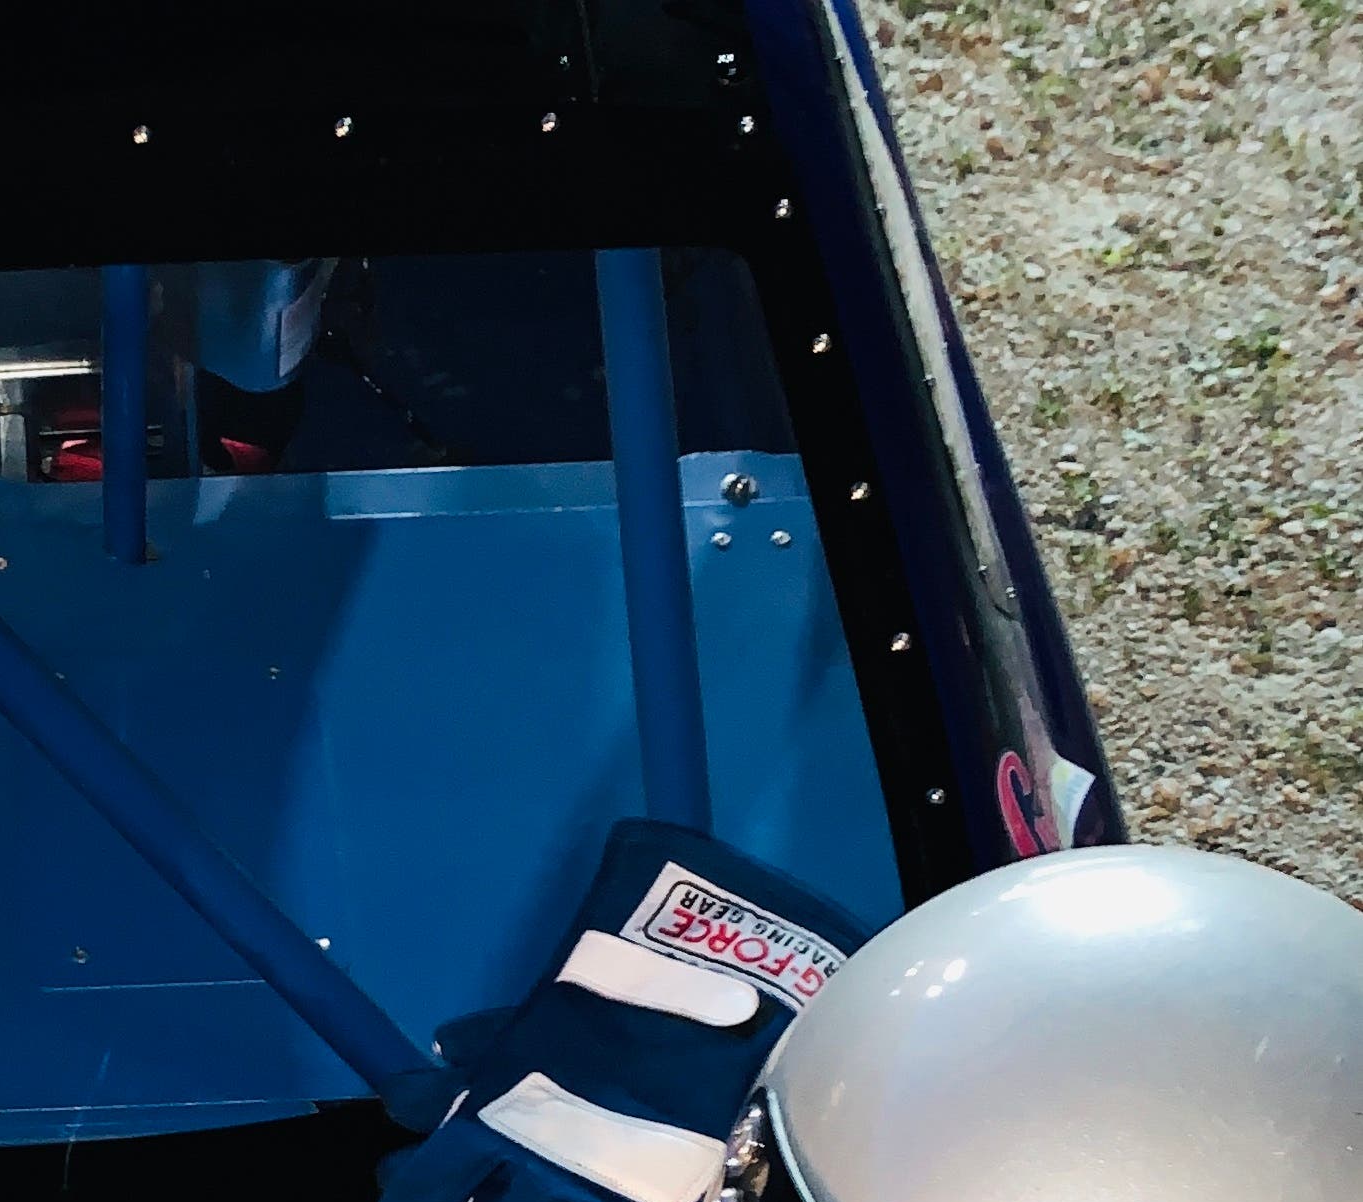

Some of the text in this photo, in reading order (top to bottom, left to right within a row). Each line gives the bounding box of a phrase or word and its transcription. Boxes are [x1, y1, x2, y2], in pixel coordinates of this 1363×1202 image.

[658, 907, 826, 998] G-FORCE
[679, 889, 841, 979] RACING GEAR
